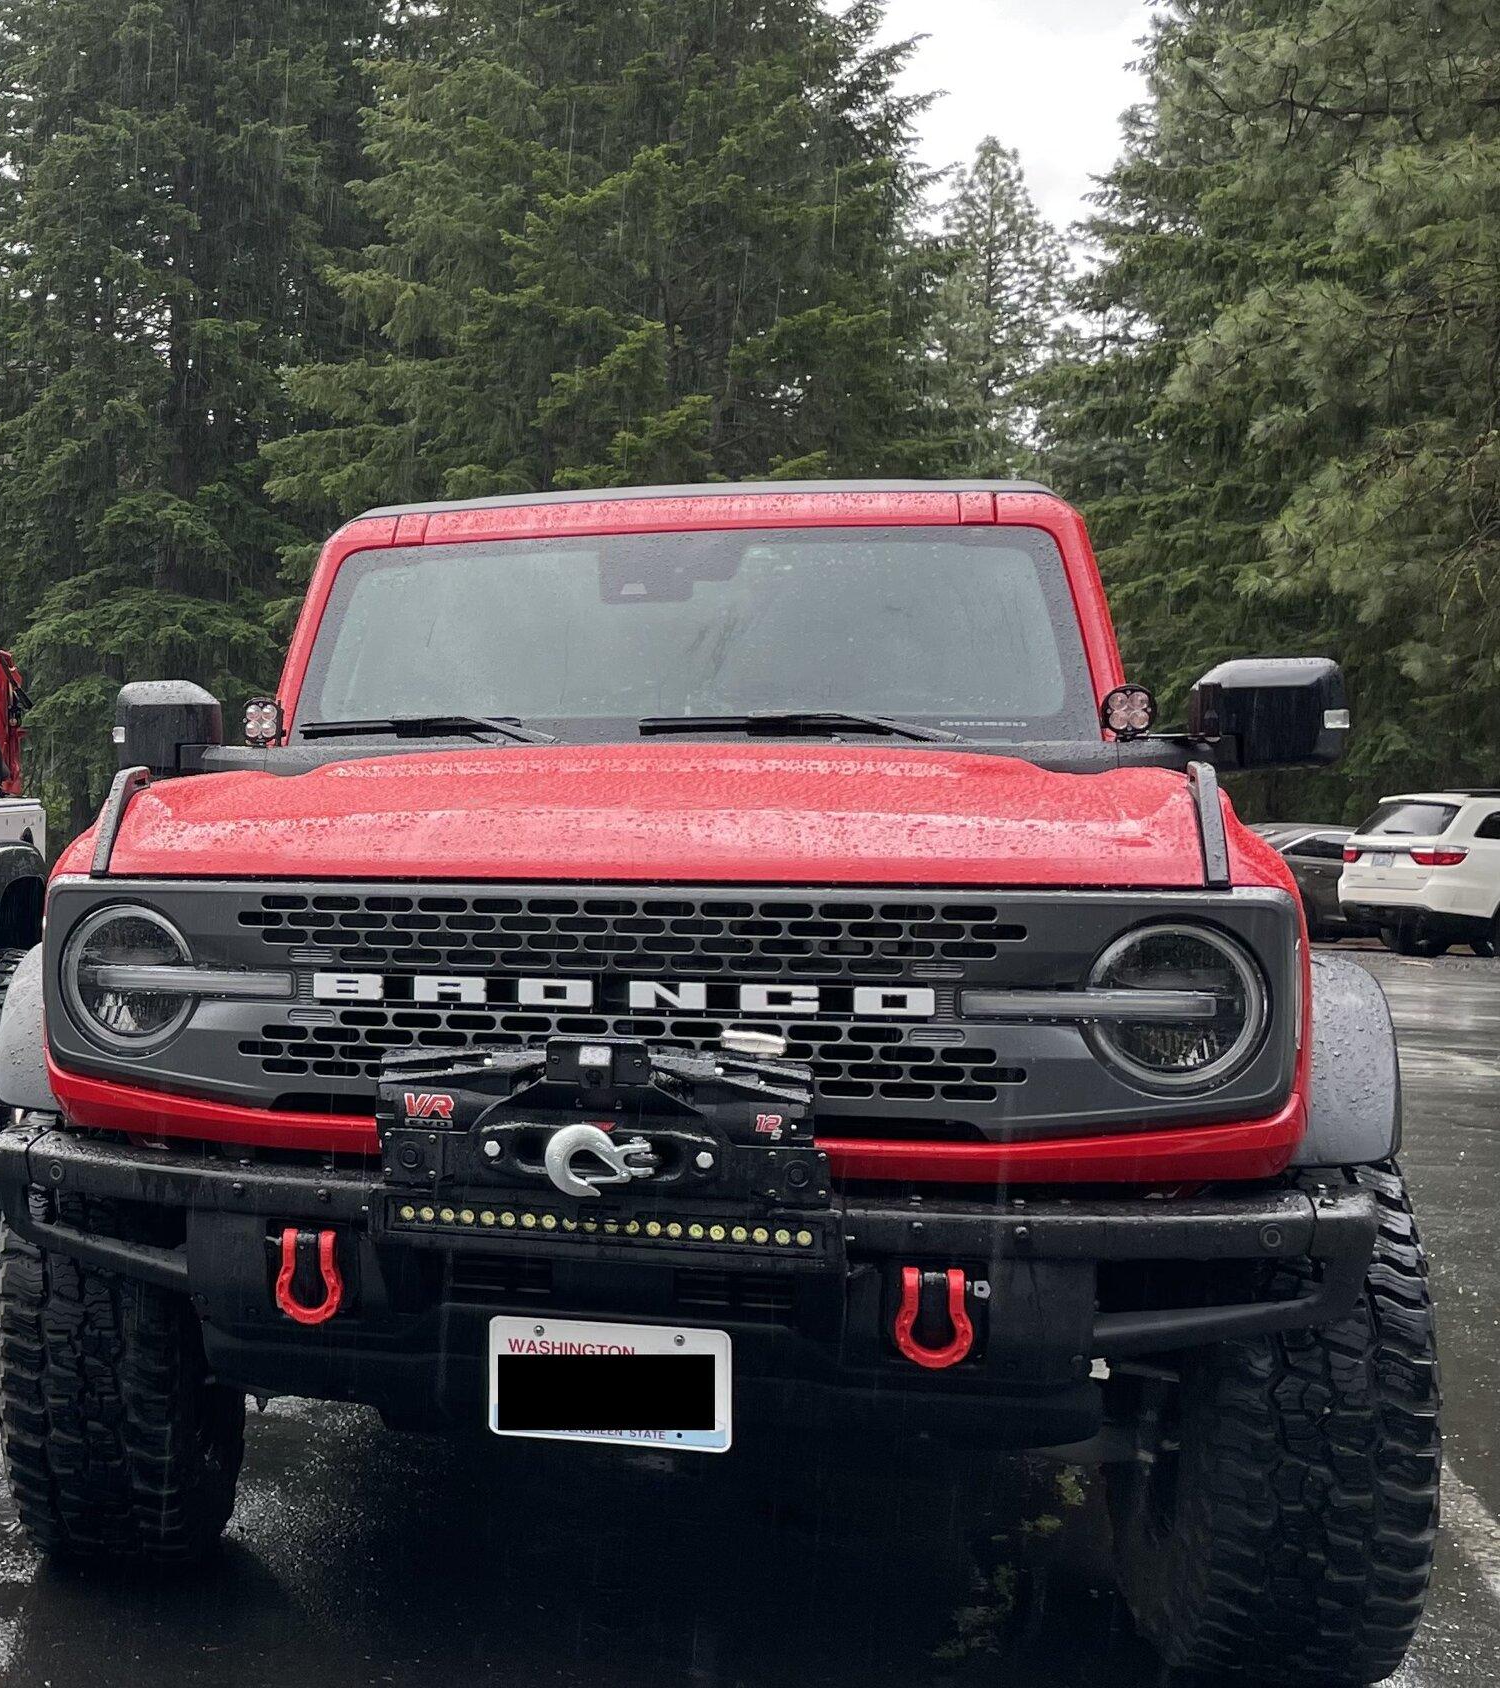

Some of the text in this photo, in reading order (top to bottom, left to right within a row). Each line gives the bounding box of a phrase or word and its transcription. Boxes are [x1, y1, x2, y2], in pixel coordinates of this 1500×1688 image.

[313, 972, 935, 1017] BRONCO
[404, 1092, 455, 1119] VR
[508, 1338, 636, 1355] WASHINGTON
[629, 1430, 666, 1440] STATE
